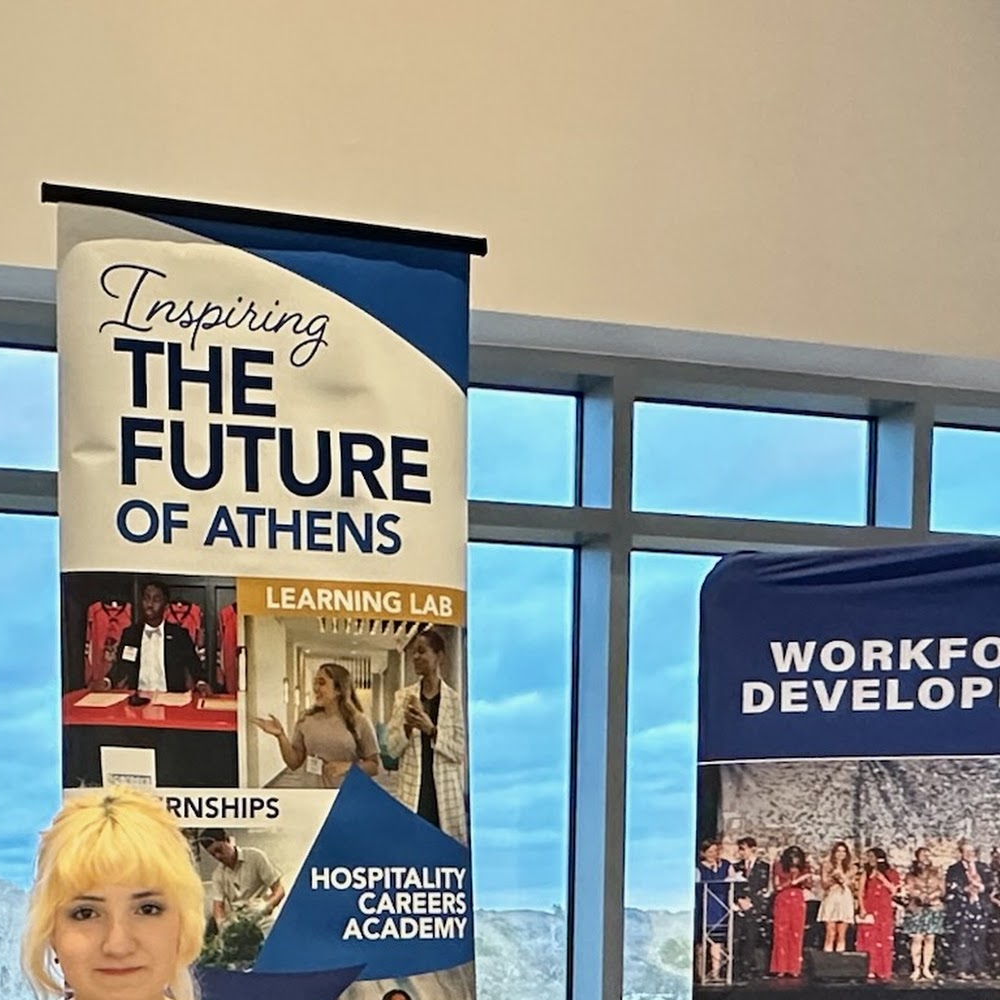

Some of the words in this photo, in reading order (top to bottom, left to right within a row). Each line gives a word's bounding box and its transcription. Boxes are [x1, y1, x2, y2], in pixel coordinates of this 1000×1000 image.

[99, 264, 330, 368] Inspiring
[113, 336, 277, 418] THE
[120, 415, 432, 505] FUTURE
[116, 498, 190, 545] OF
[203, 504, 403, 555] ATHENS
[265, 586, 402, 614] LEARNING
[410, 592, 453, 617] LAB
[740, 676, 1000, 714] DEVELOP
[166, 797, 280, 819] RNSHIPS
[310, 866, 468, 891] HOSPITALITY
[357, 891, 468, 916] CAREERS
[342, 916, 468, 941] ACADEMY
